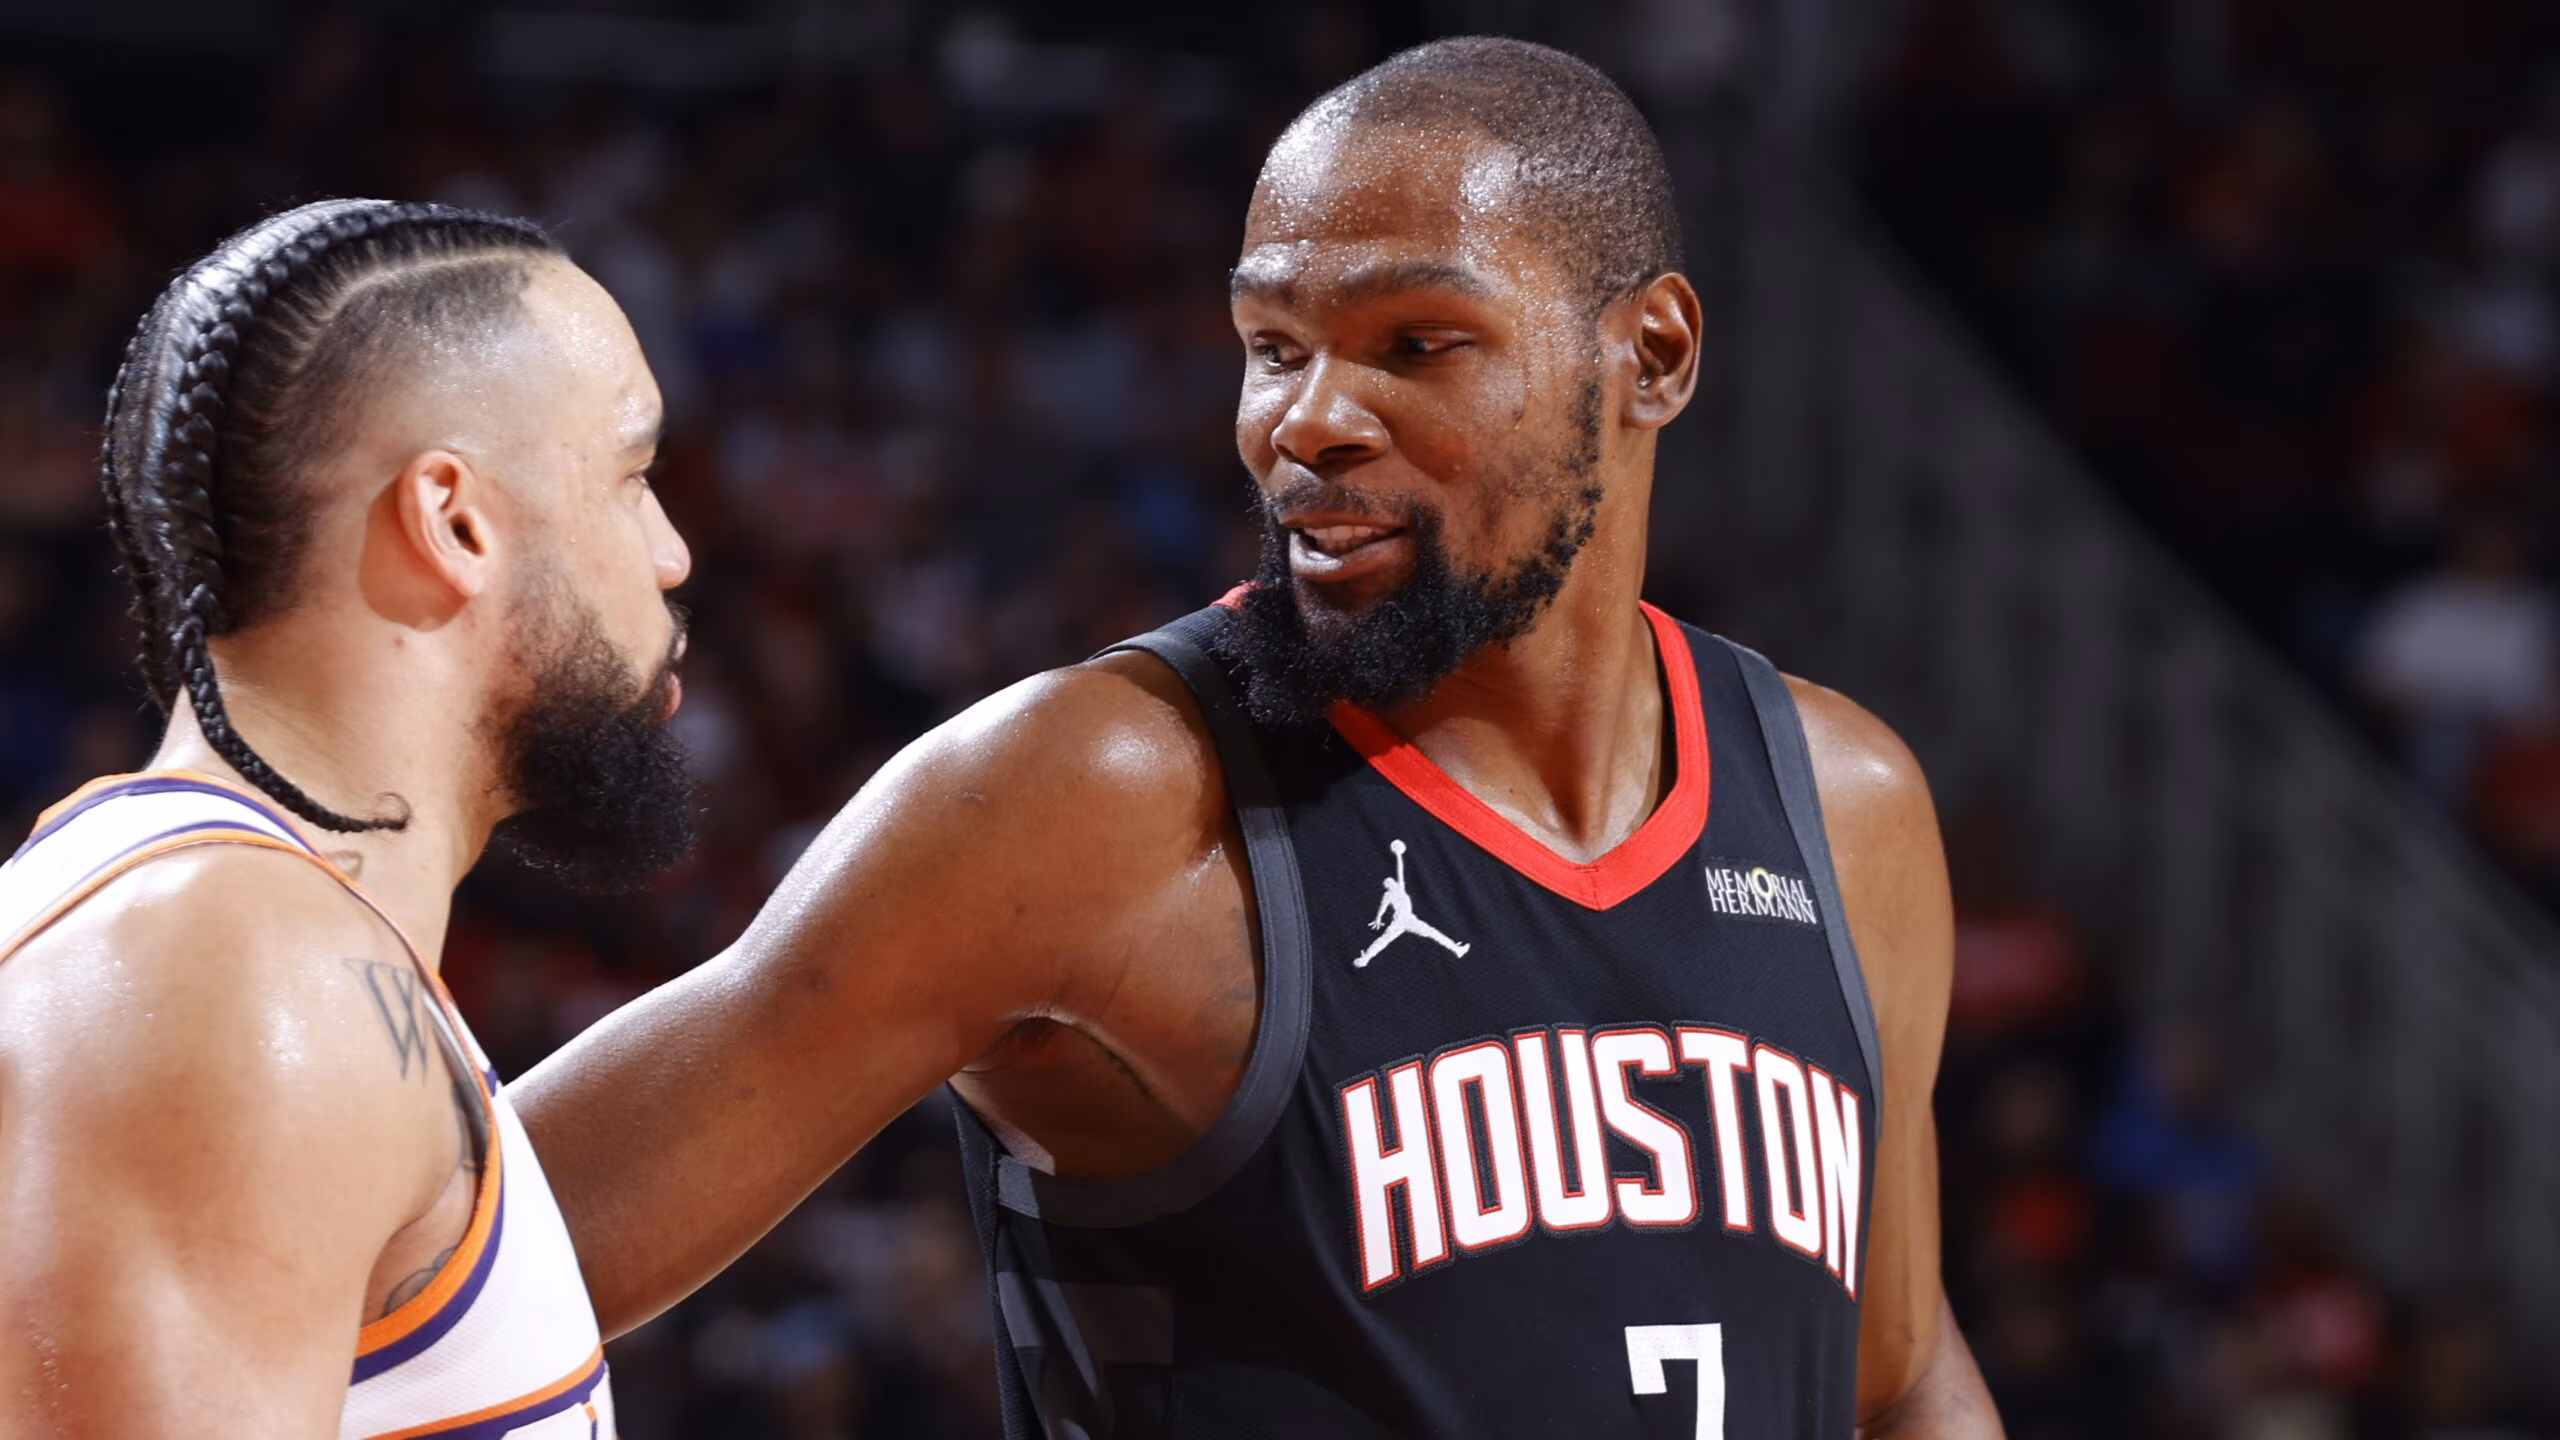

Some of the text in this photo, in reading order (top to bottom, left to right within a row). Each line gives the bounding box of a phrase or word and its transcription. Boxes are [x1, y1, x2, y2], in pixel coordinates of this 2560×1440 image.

[1705, 867, 1813, 903] MEMORIAL
[1708, 887, 1817, 924] HERMANN
[1340, 1026, 1861, 1302] HOUSTON
[1624, 1322, 1726, 1440] 7
